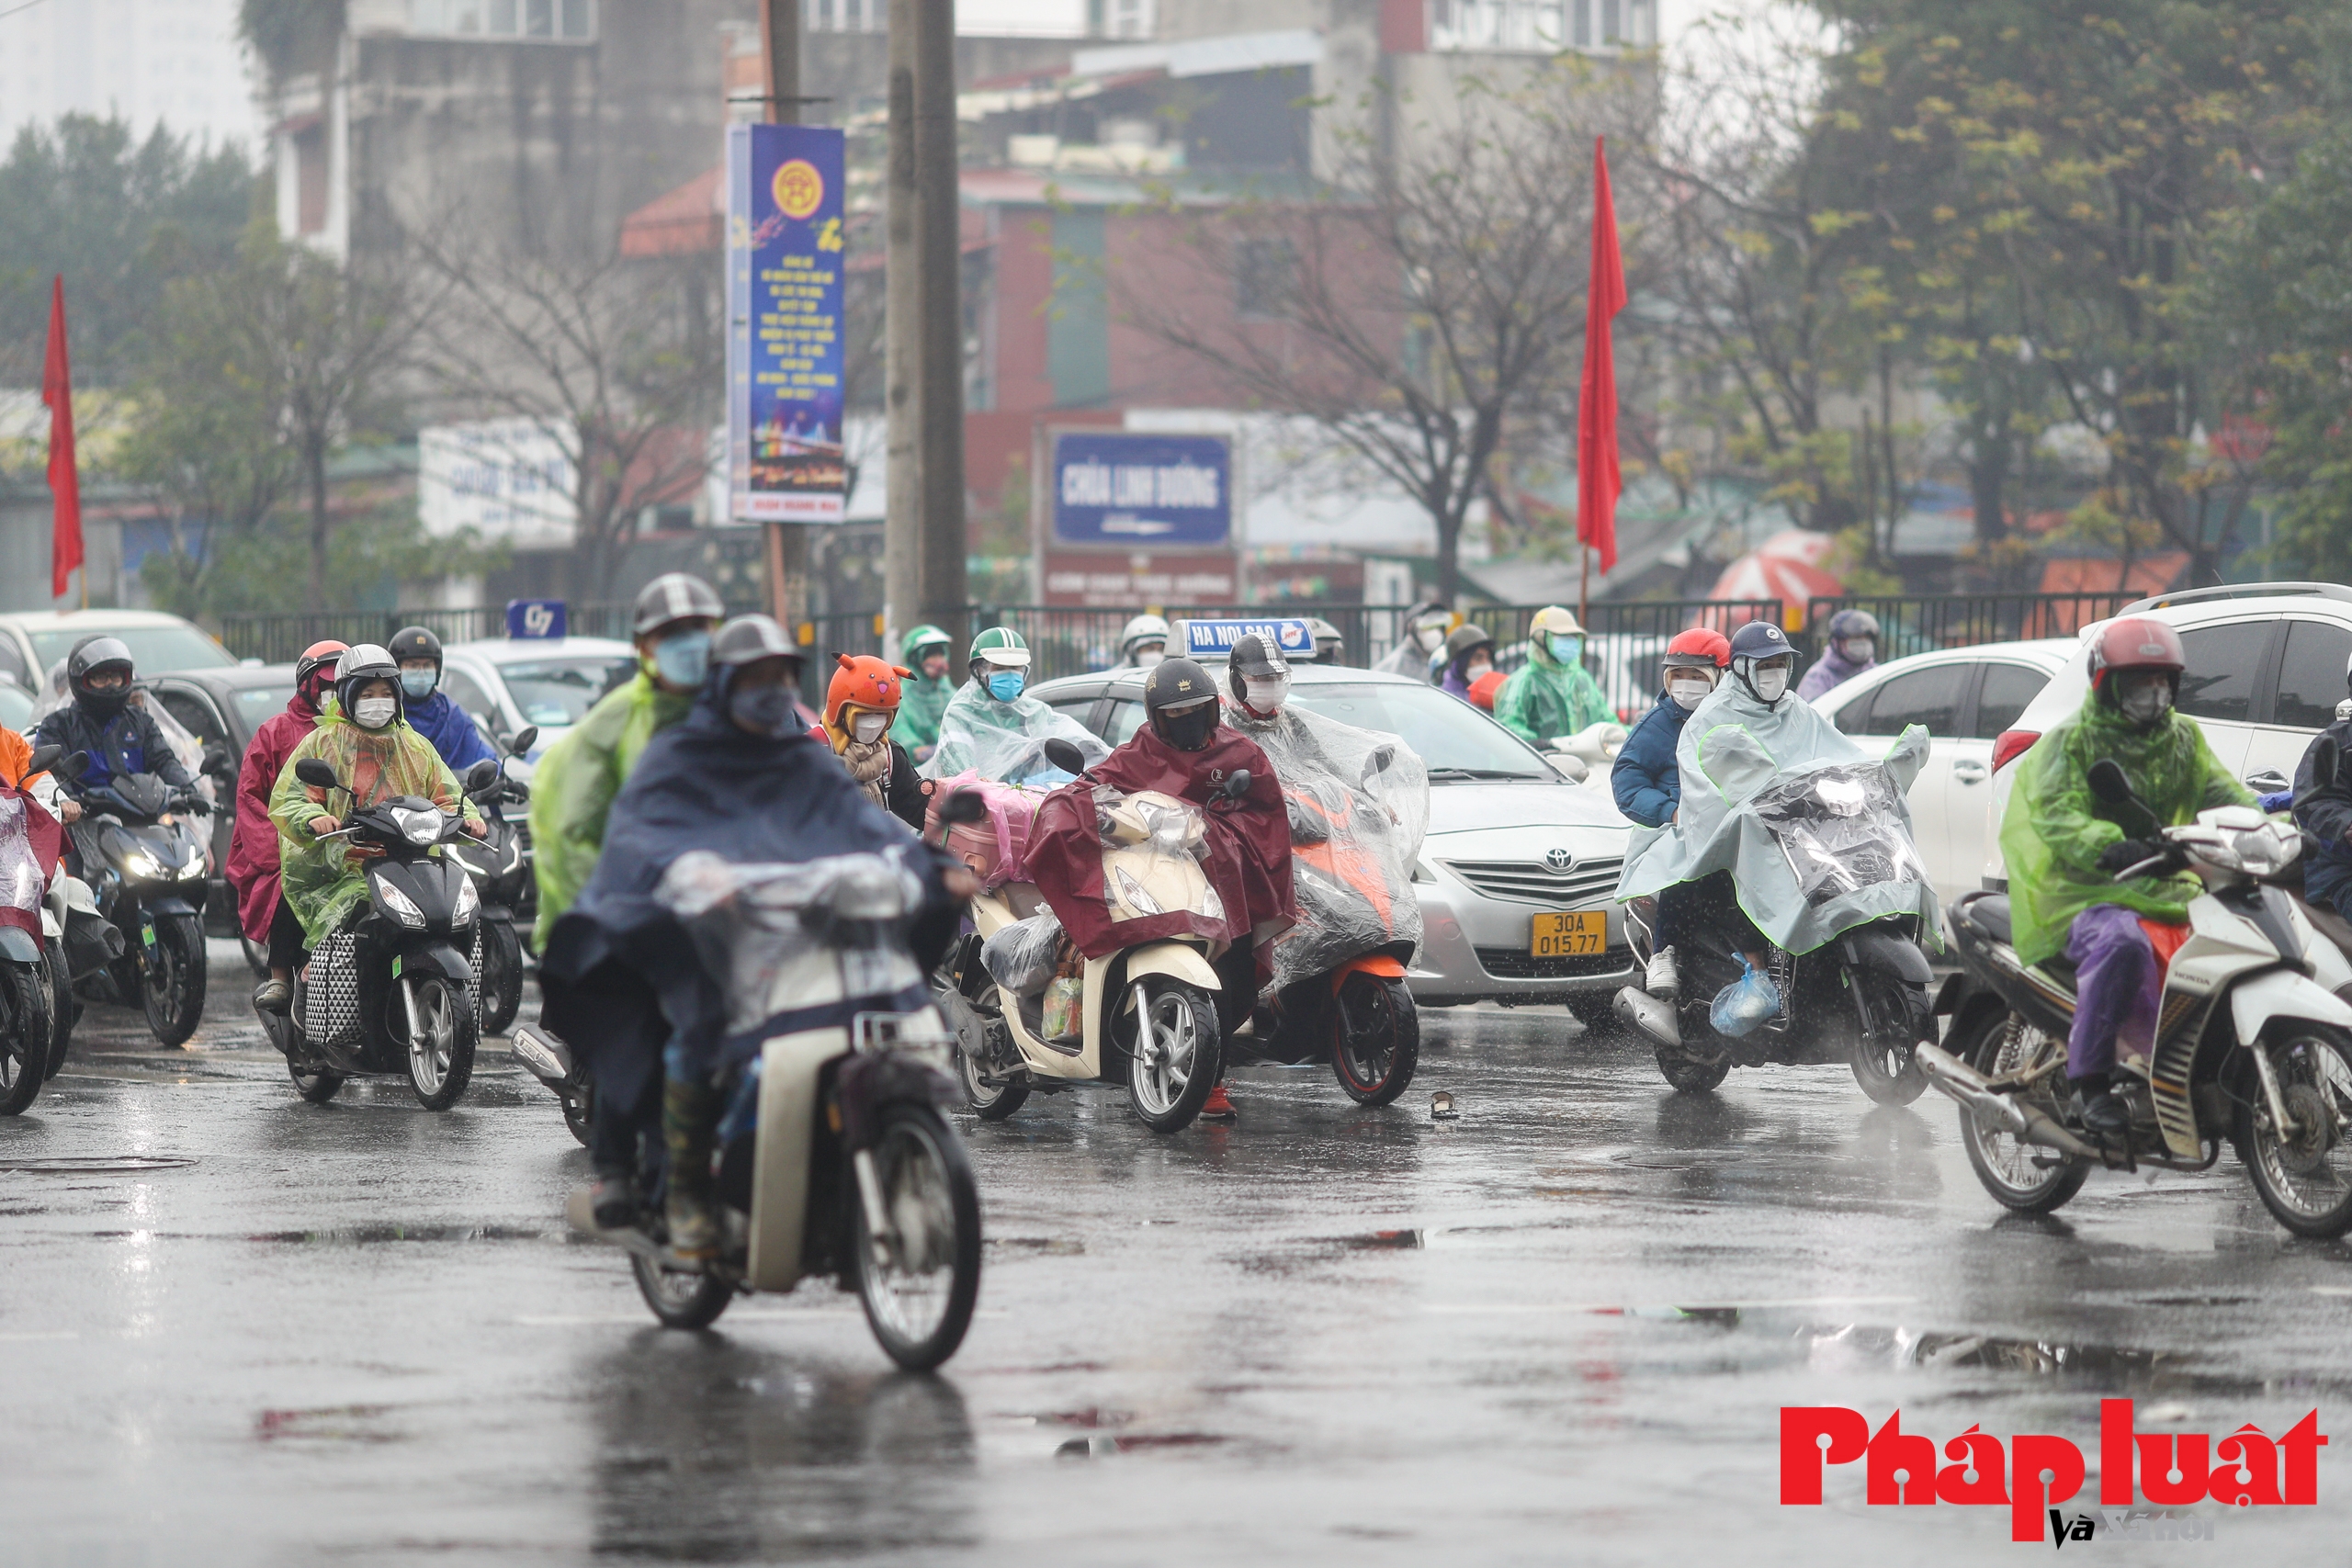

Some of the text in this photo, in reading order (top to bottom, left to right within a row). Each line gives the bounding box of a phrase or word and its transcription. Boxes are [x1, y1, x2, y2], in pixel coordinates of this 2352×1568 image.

[1191, 626, 1215, 646] HA
[1554, 915, 1584, 932] 30A
[1540, 934, 1598, 953] 015.77
[2174, 971, 2210, 985] HONDA
